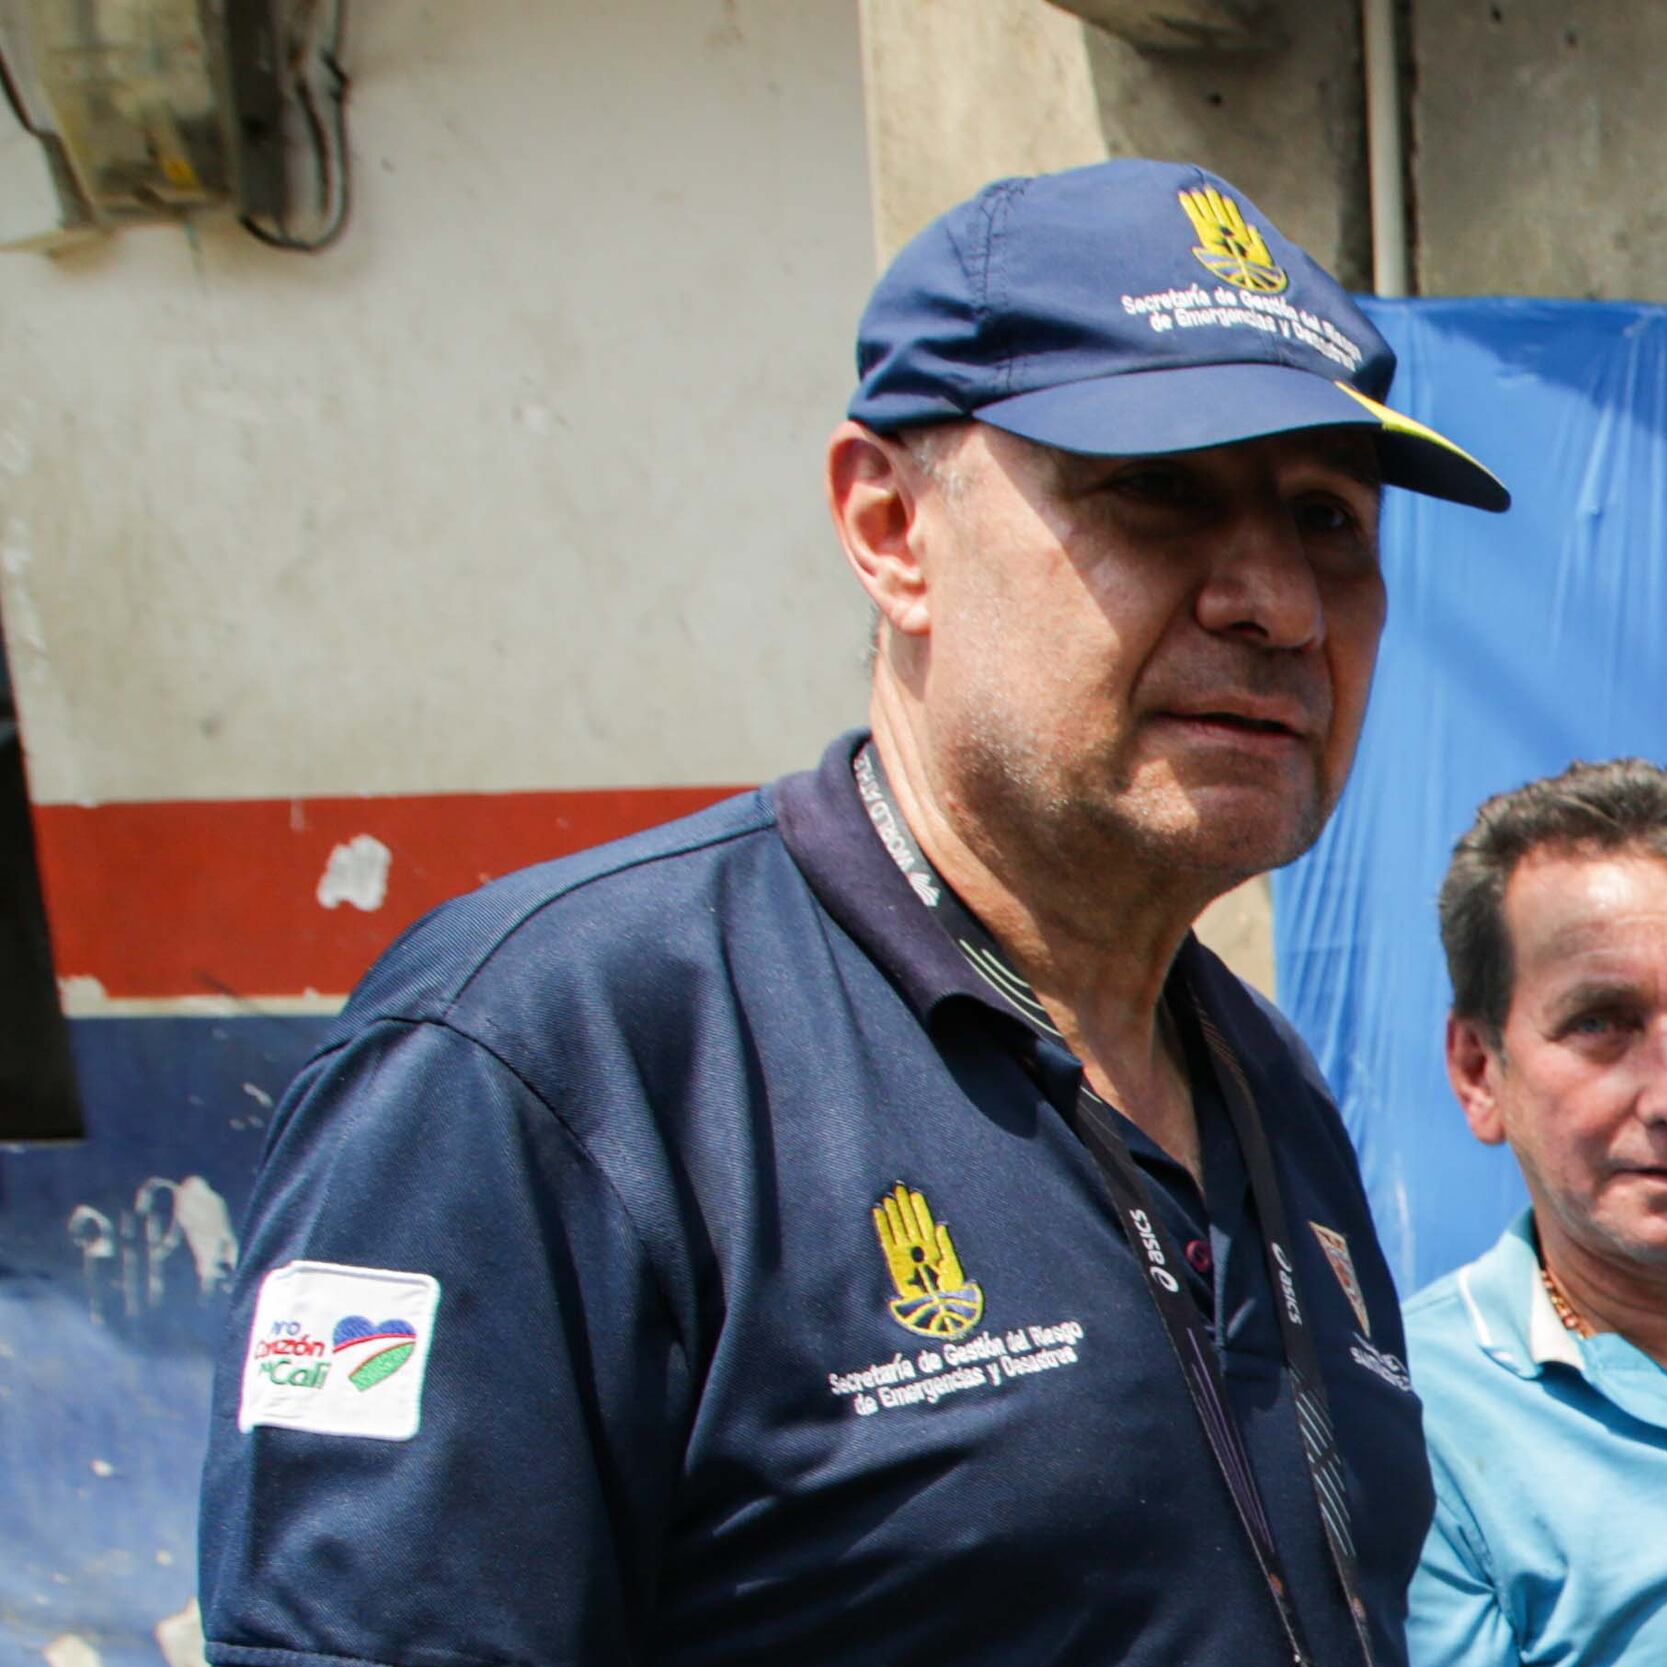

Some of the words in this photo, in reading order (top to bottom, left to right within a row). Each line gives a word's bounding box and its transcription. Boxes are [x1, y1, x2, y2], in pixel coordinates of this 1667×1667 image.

[1121, 283, 1211, 315] Secretaría
[1214, 287, 1237, 306] de
[1150, 311, 1173, 333] de
[828, 1352, 916, 1396] Secretaría
[917, 1349, 943, 1374] de
[1006, 1328, 1031, 1353] del
[1028, 1320, 1084, 1347] Riesgo
[853, 1393, 879, 1416] de
[878, 1365, 987, 1404] Emergencias
[986, 1363, 1002, 1387] y
